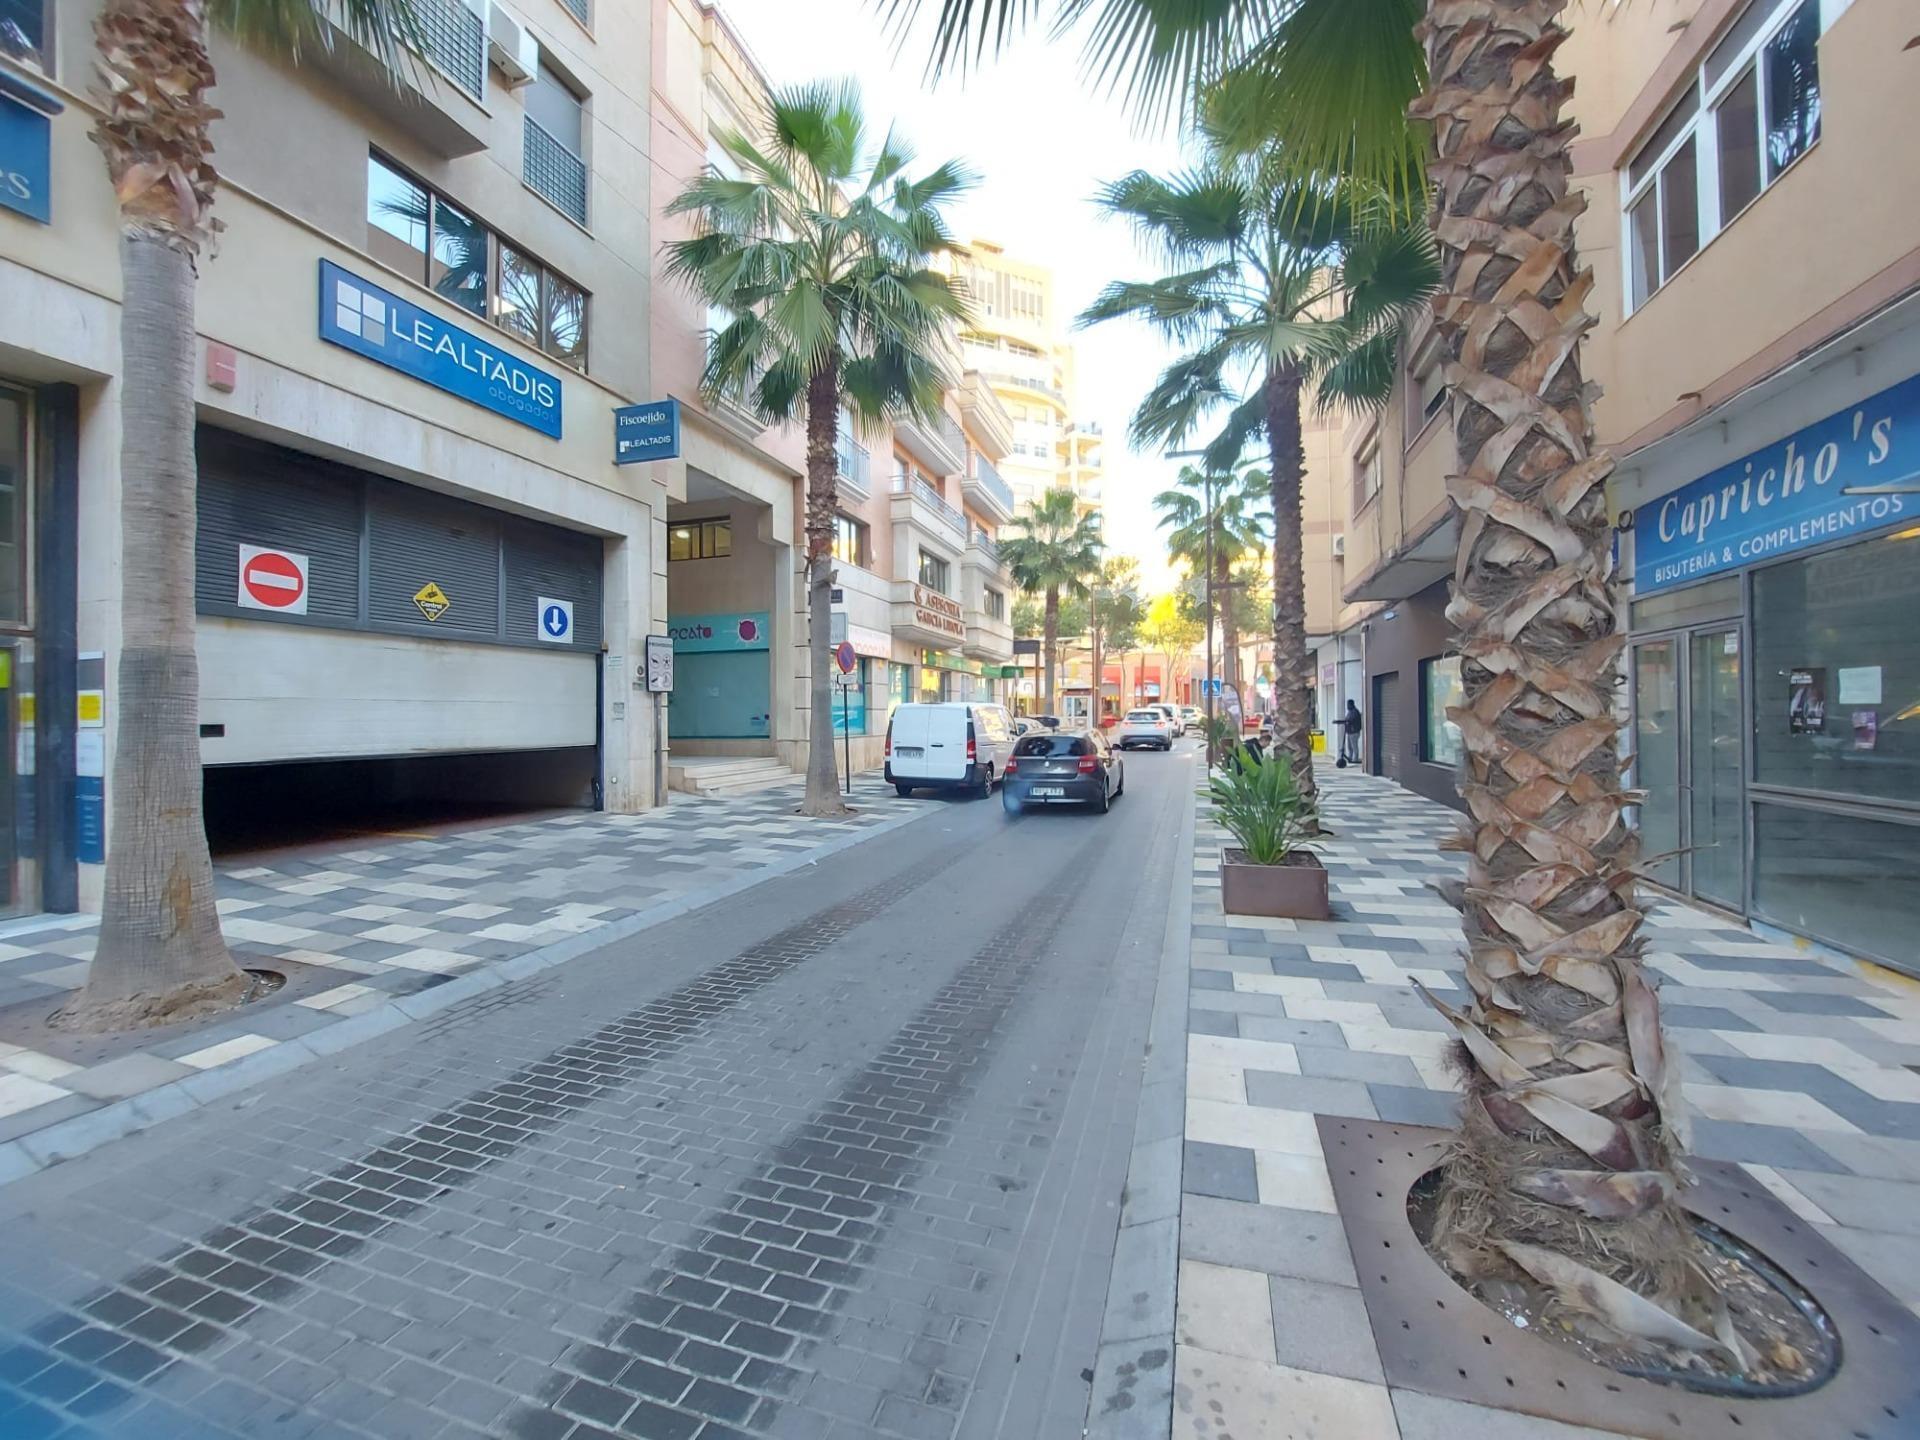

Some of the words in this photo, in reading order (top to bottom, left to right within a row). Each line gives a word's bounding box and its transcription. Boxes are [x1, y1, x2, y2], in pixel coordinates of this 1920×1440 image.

[391, 307, 554, 408] LEALTADIS
[488, 386, 555, 424] abogados
[620, 411, 666, 427] Fiscoejido
[630, 435, 672, 448] LEALTADIS
[1658, 410, 1892, 544] Capricho's
[1655, 549, 1717, 583] BISUTERÍA
[1722, 546, 1733, 563] &
[1739, 493, 1904, 558] COMPLEMENTOS
